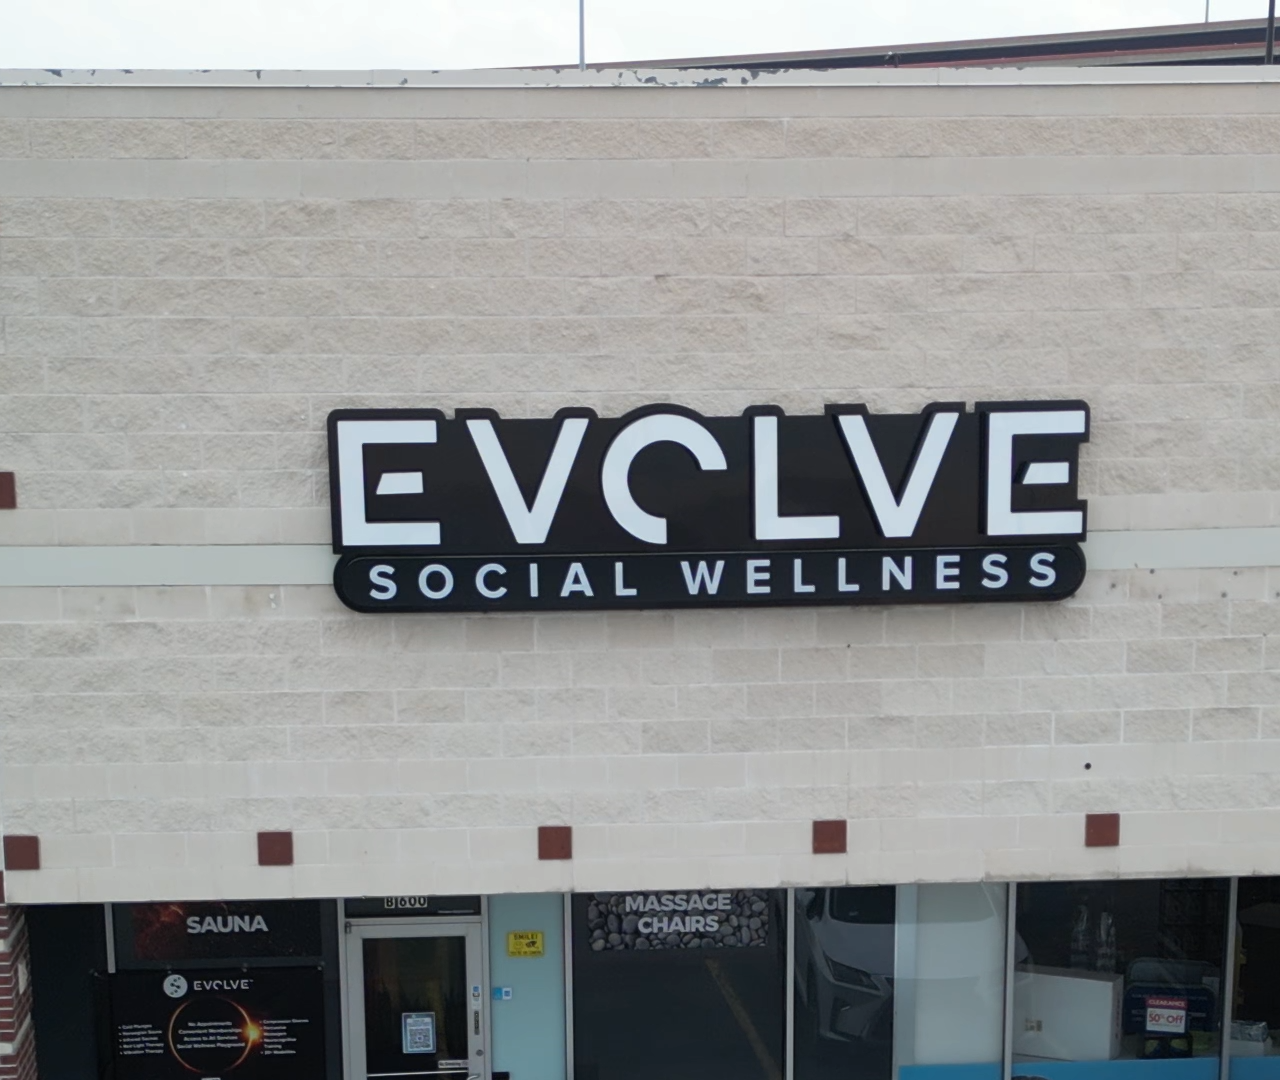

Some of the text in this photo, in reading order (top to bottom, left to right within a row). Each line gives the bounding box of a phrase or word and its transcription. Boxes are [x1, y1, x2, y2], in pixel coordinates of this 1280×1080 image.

[336, 410, 1086, 545] EVOLVE
[368, 552, 1058, 600] SOCIAL WELLNESS
[385, 897, 427, 908] B 600
[625, 893, 732, 912] MASSAGE
[186, 915, 269, 934] SAUNA
[638, 915, 719, 933] CHAIRS
[193, 980, 250, 991] EVOLVE
[1166, 1014, 1184, 1024] Off
